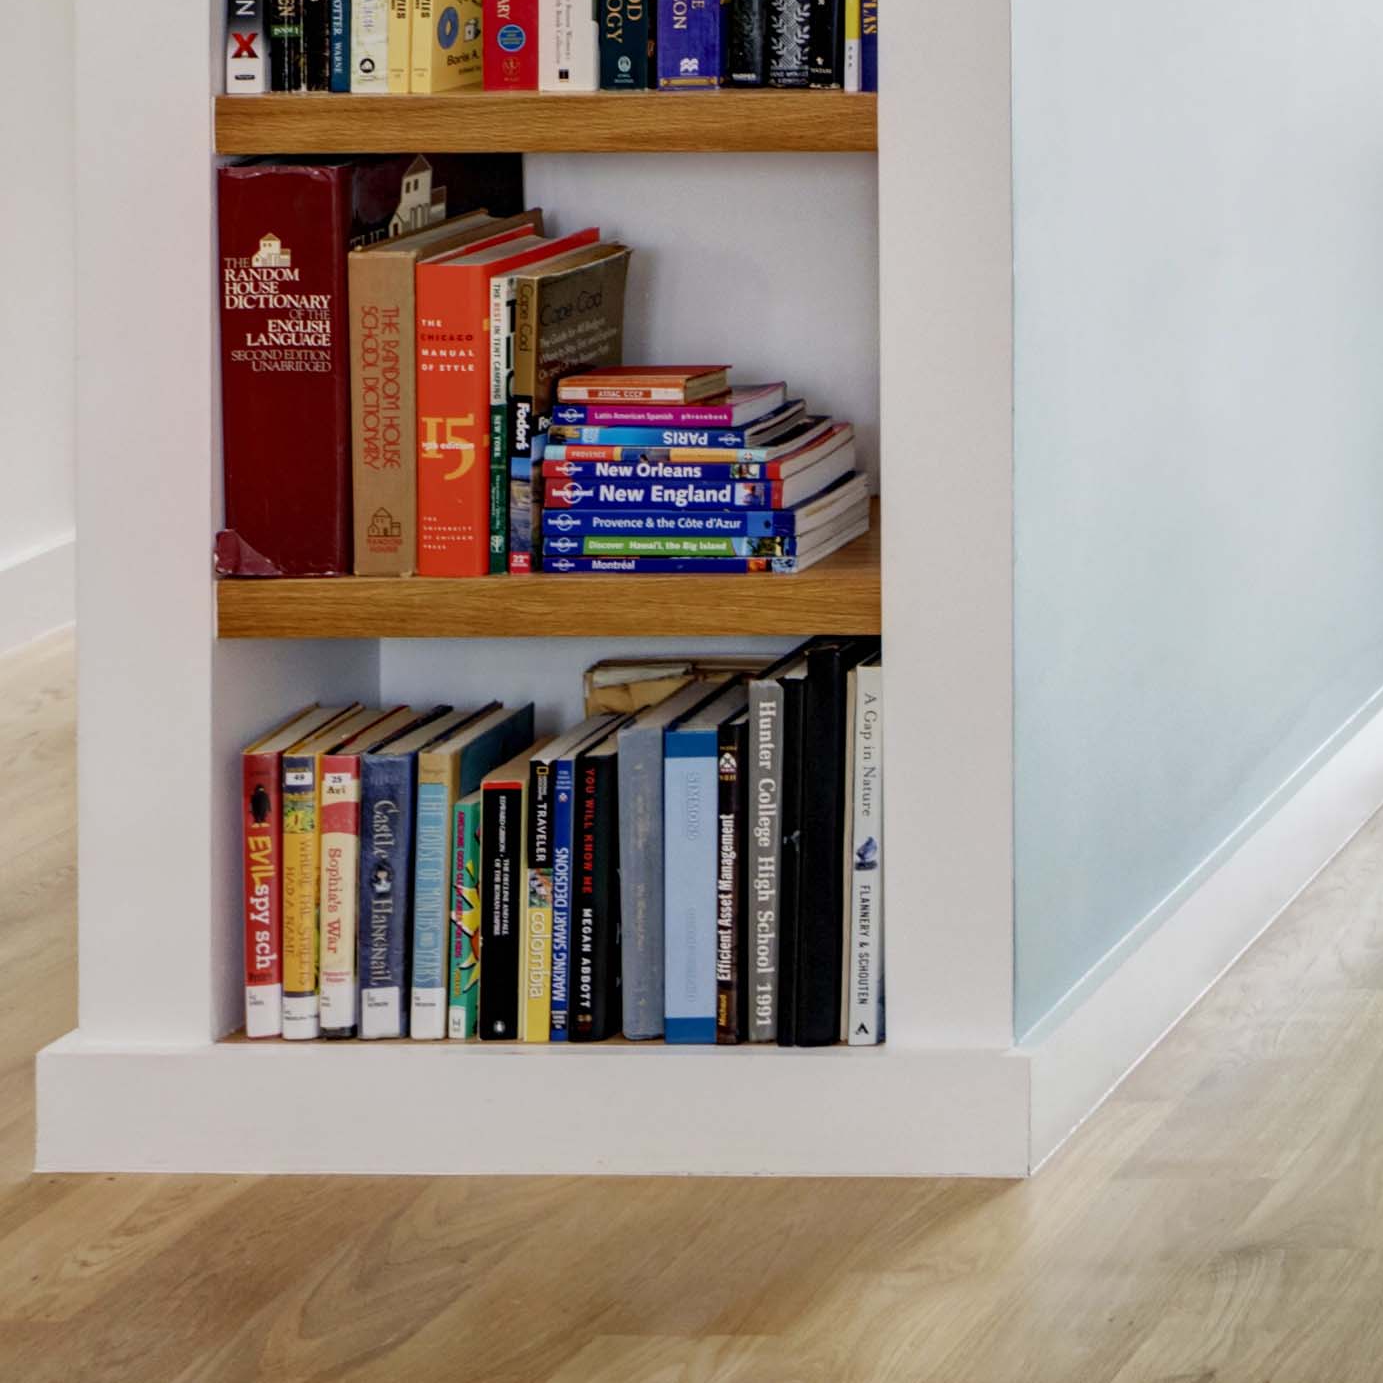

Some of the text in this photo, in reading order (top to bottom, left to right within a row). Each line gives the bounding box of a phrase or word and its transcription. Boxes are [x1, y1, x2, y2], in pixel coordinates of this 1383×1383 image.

[224, 257, 250, 269] THE
[224, 268, 300, 282] RANDOM
[224, 281, 279, 295] HOUSE
[224, 295, 331, 310] DICTIONARY
[288, 308, 331, 320] OF THE
[267, 320, 331, 334] ENGLISH
[421, 319, 443, 328] THE
[246, 333, 331, 348] LANGUAGE
[420, 334, 474, 342] CHICAGO
[231, 350, 331, 362] SECOND EDITION
[421, 349, 474, 358] MANUAL
[251, 360, 332, 373] UNABRIDGED
[421, 364, 475, 372] OF STYLE
[515, 402, 531, 451] Fodor's
[663, 431, 708, 446] PARIS
[421, 413, 476, 481] 15
[596, 462, 702, 478] New Orleans
[599, 484, 732, 507] New England
[593, 516, 743, 530] Provence & the Côte d'Azur
[592, 559, 636, 571] Montréal
[860, 692, 877, 817] A Gap in Nature
[535, 803, 548, 862] TRAVELER
[247, 835, 273, 884] EVIL
[754, 700, 777, 1027] Hunter College High School 1991
[250, 884, 270, 924] spy
[326, 848, 343, 954] Sophia's War
[858, 885, 871, 938] FLANNERY
[529, 911, 548, 999] colombia
[579, 908, 593, 1009] MEGAN ABBOTT
[857, 952, 870, 1005] SCHOUTEN
